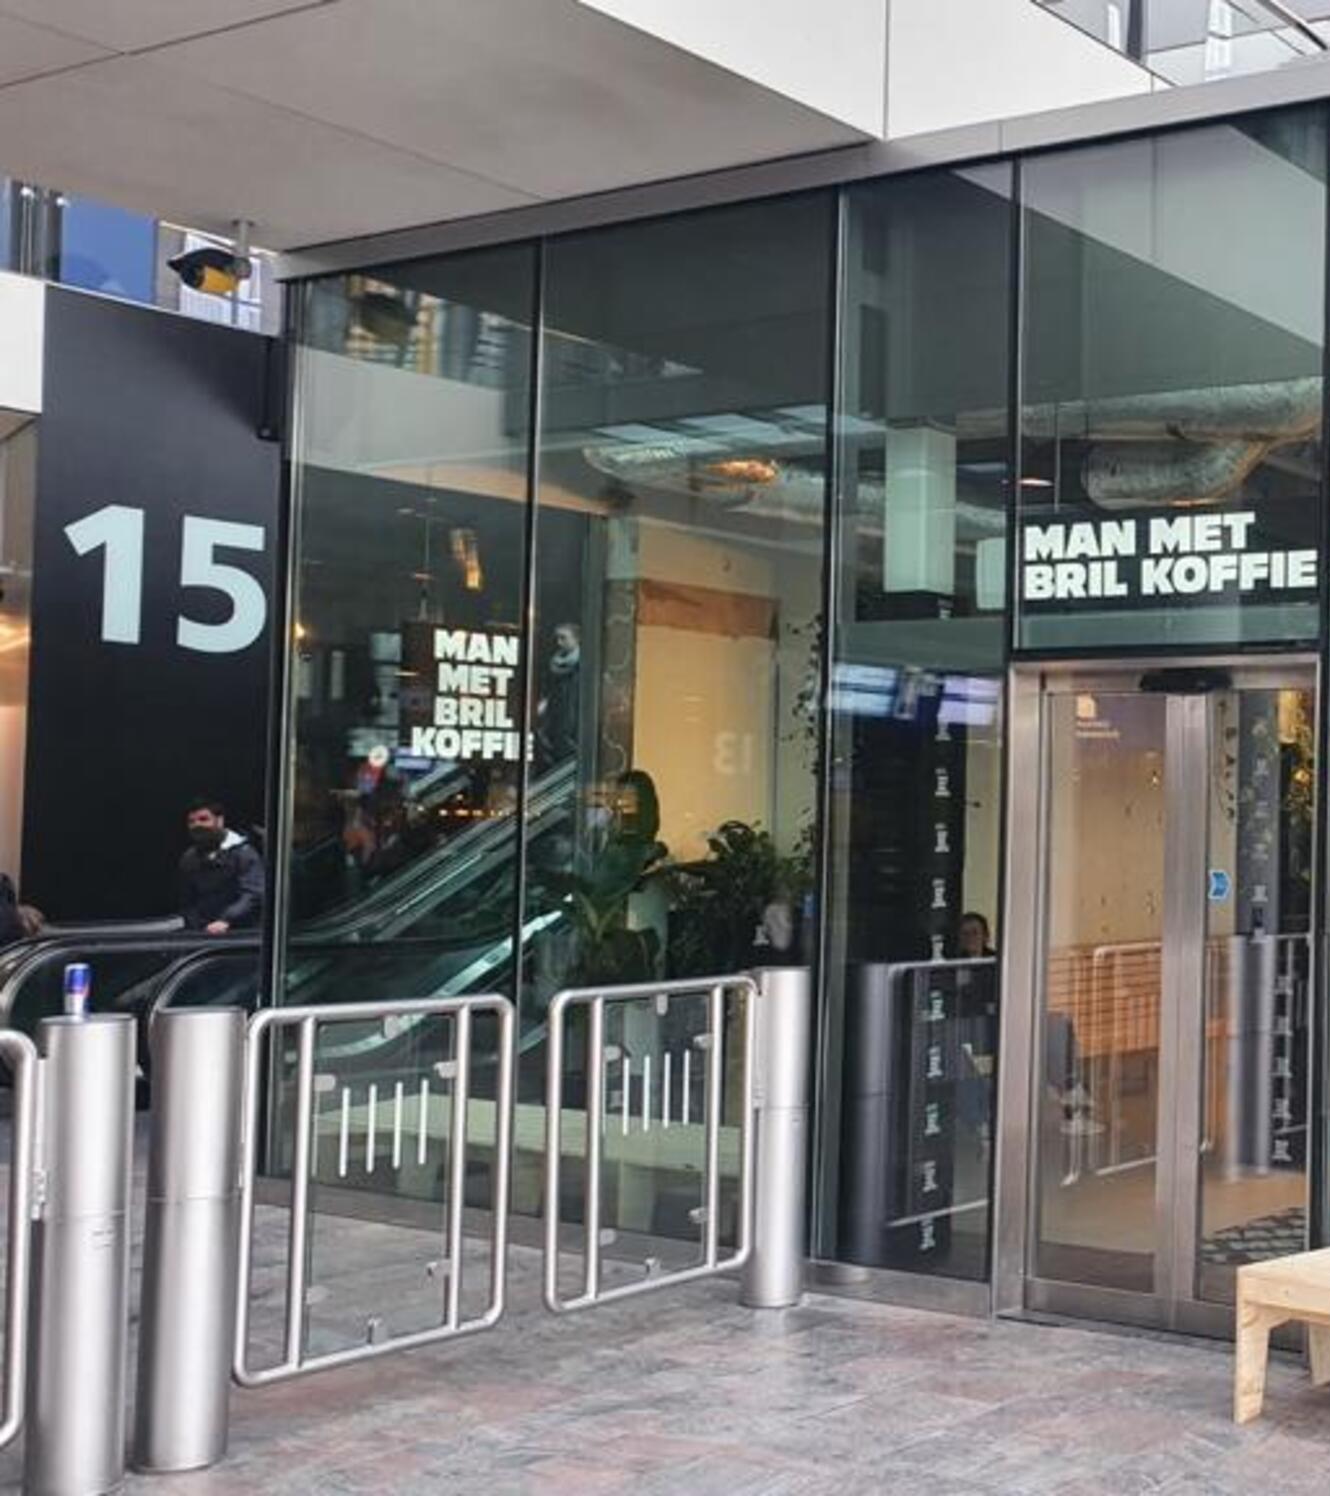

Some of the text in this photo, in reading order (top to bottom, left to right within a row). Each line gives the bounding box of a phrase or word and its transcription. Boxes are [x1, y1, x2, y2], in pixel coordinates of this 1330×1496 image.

[1024, 511, 1255, 562] MAN MET
[63, 504, 267, 653] 15
[1024, 549, 1318, 600] BRIL KOFFIE
[433, 628, 519, 666] MAN
[438, 661, 514, 696] MET
[434, 695, 514, 728] BRIL
